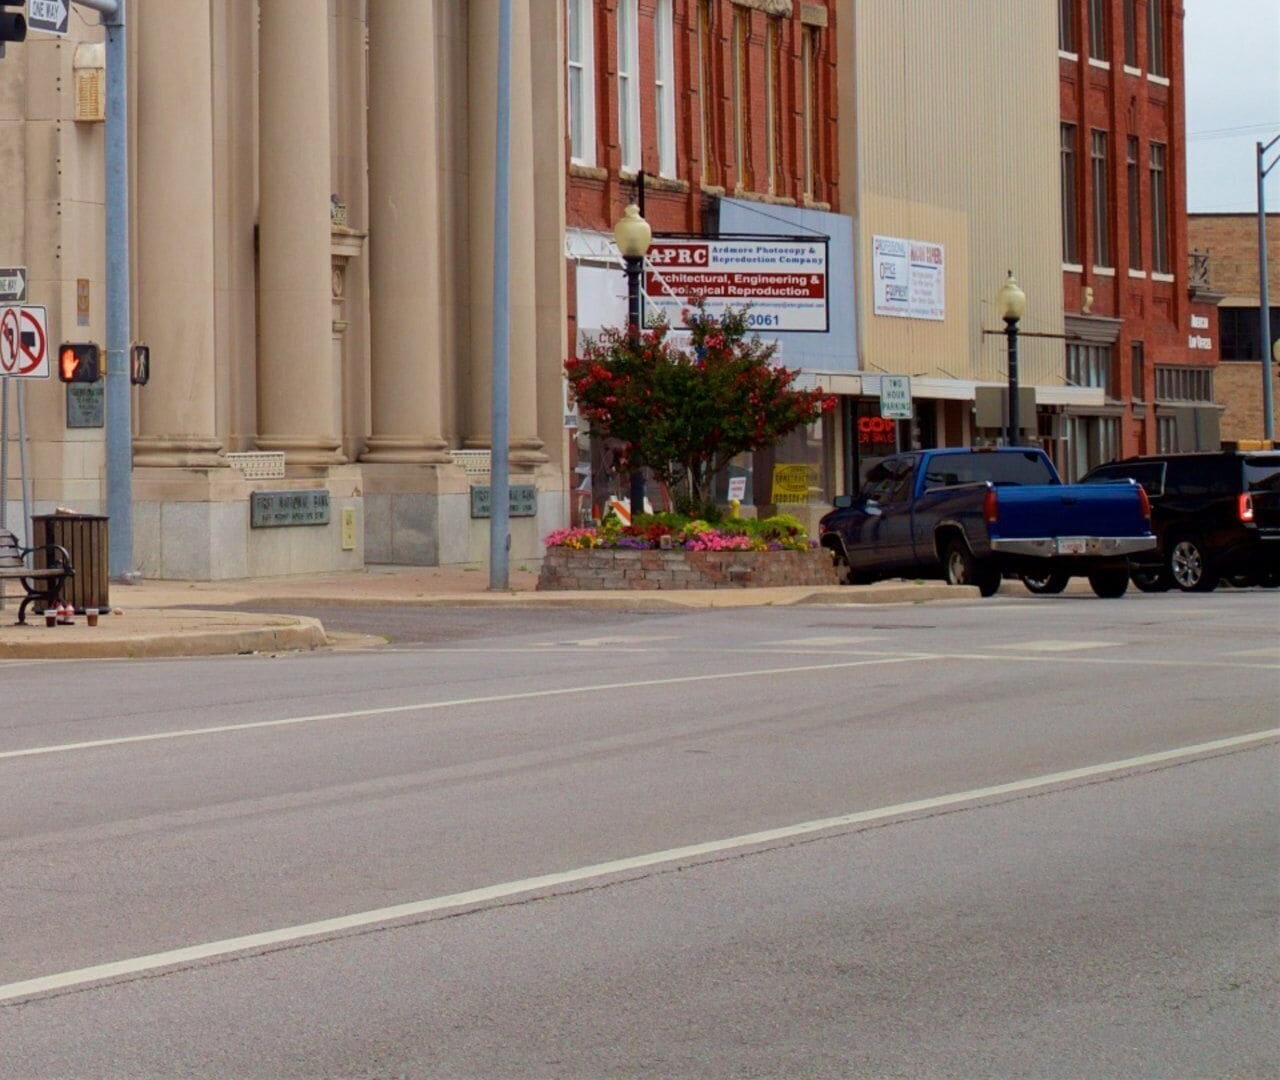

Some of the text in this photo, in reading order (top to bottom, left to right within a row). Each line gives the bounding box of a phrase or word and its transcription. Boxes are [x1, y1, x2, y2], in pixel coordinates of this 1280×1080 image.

[32, 0, 59, 22] ONE WAY
[648, 249, 707, 264] APRC
[712, 246, 753, 254] Ardmore
[756, 247, 806, 256] Photocopy
[712, 256, 823, 265] Reproduction Company
[651, 274, 820, 286] Architectural, Engineering &
[728, 287, 810, 296] Reproduction
